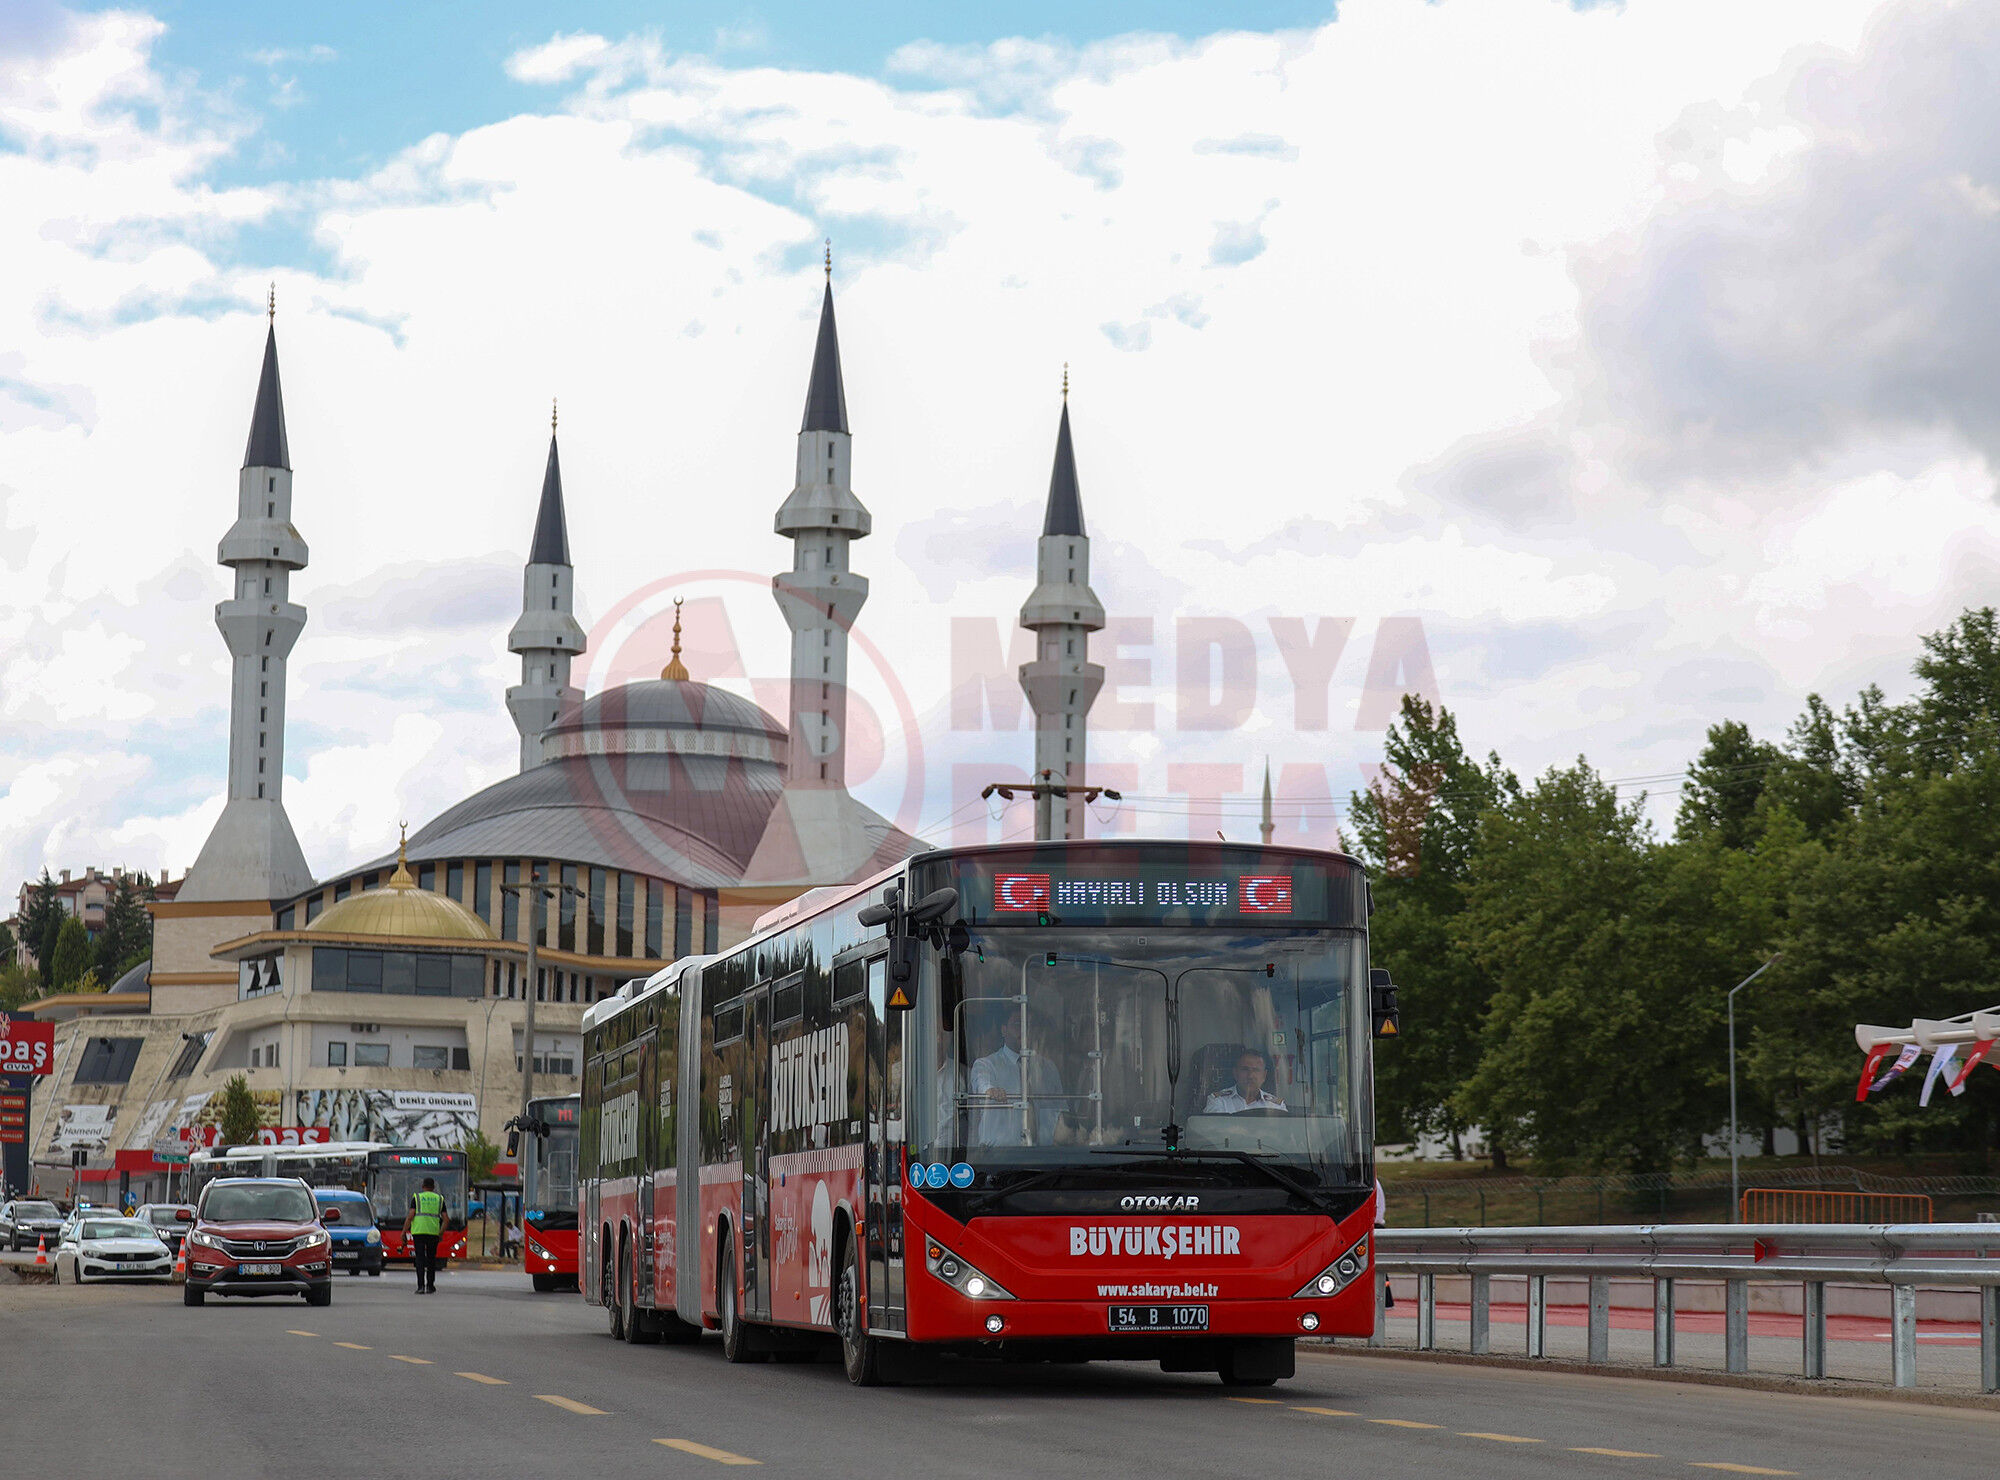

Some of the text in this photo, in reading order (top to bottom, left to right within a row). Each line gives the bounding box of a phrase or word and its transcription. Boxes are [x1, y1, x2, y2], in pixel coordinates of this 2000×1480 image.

[1058, 882, 1227, 905] HAYIRLI OLSUN
[770, 1021, 849, 1142] BÜYÜKŞEHİR
[400, 1096, 473, 1107] DENİZ ÜRÜNLERİ
[1120, 1196, 1200, 1211] OTOKAR
[1069, 1225, 1241, 1260] BÜYÜKŞEHİR
[1097, 1282, 1219, 1299] www.sakarya.bel.tr
[1119, 1308, 1206, 1325] 54 B 1070
